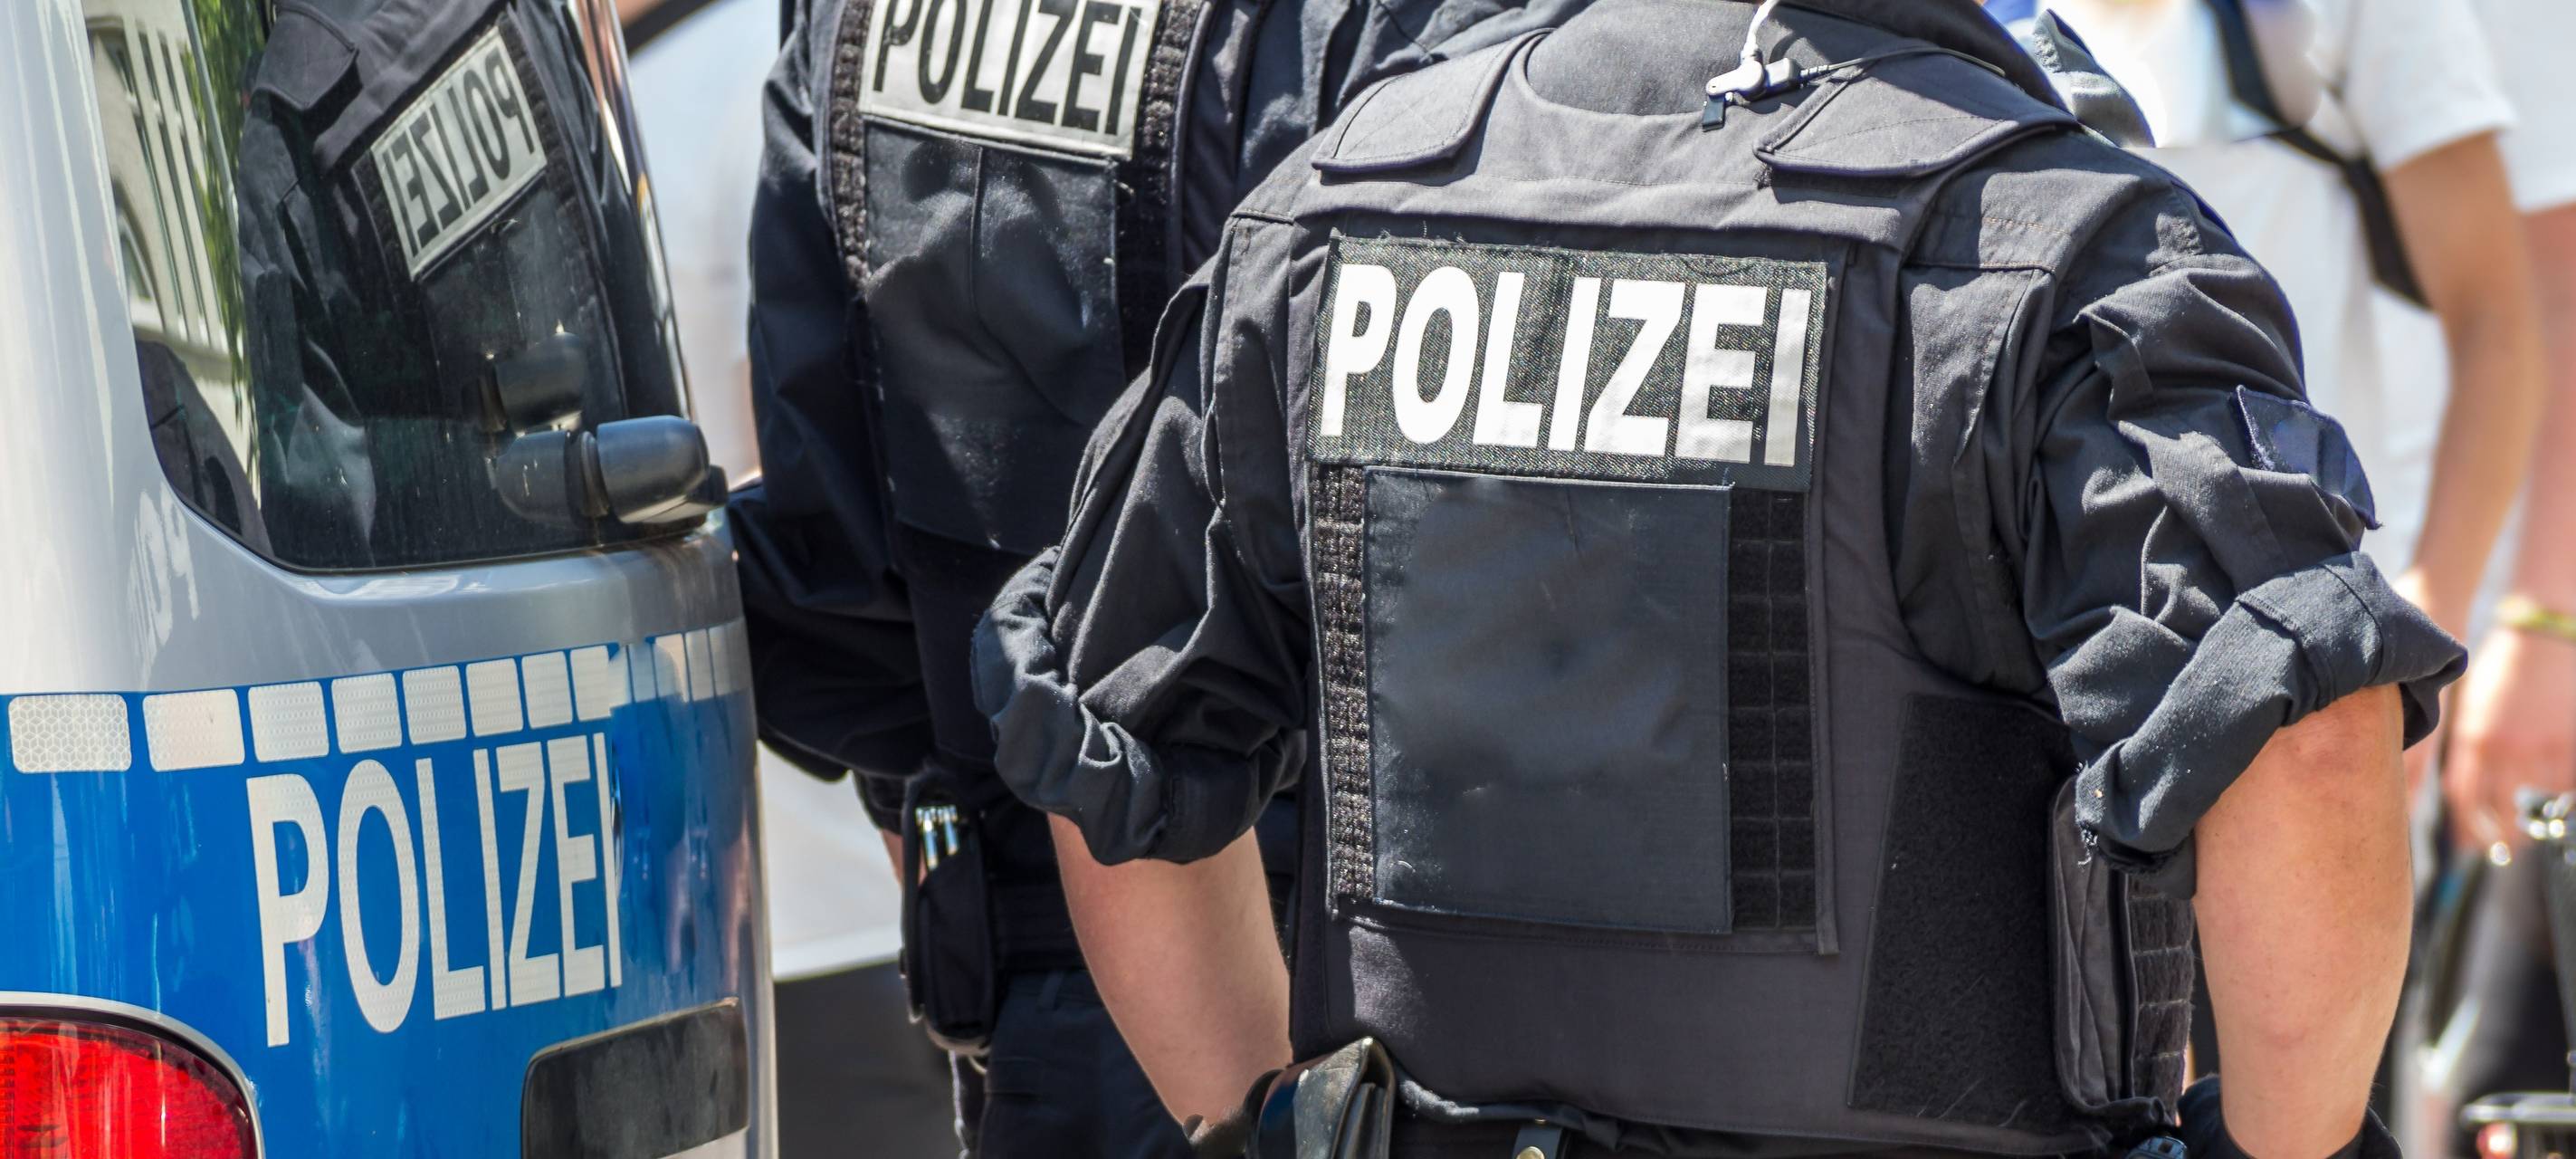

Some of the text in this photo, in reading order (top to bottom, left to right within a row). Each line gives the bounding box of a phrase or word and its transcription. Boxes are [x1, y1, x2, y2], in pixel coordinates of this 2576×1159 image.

[873, 0, 1141, 135] POLIZEI
[1320, 263, 1811, 466] POLIZEI
[246, 732, 622, 1048] POLIZEI
